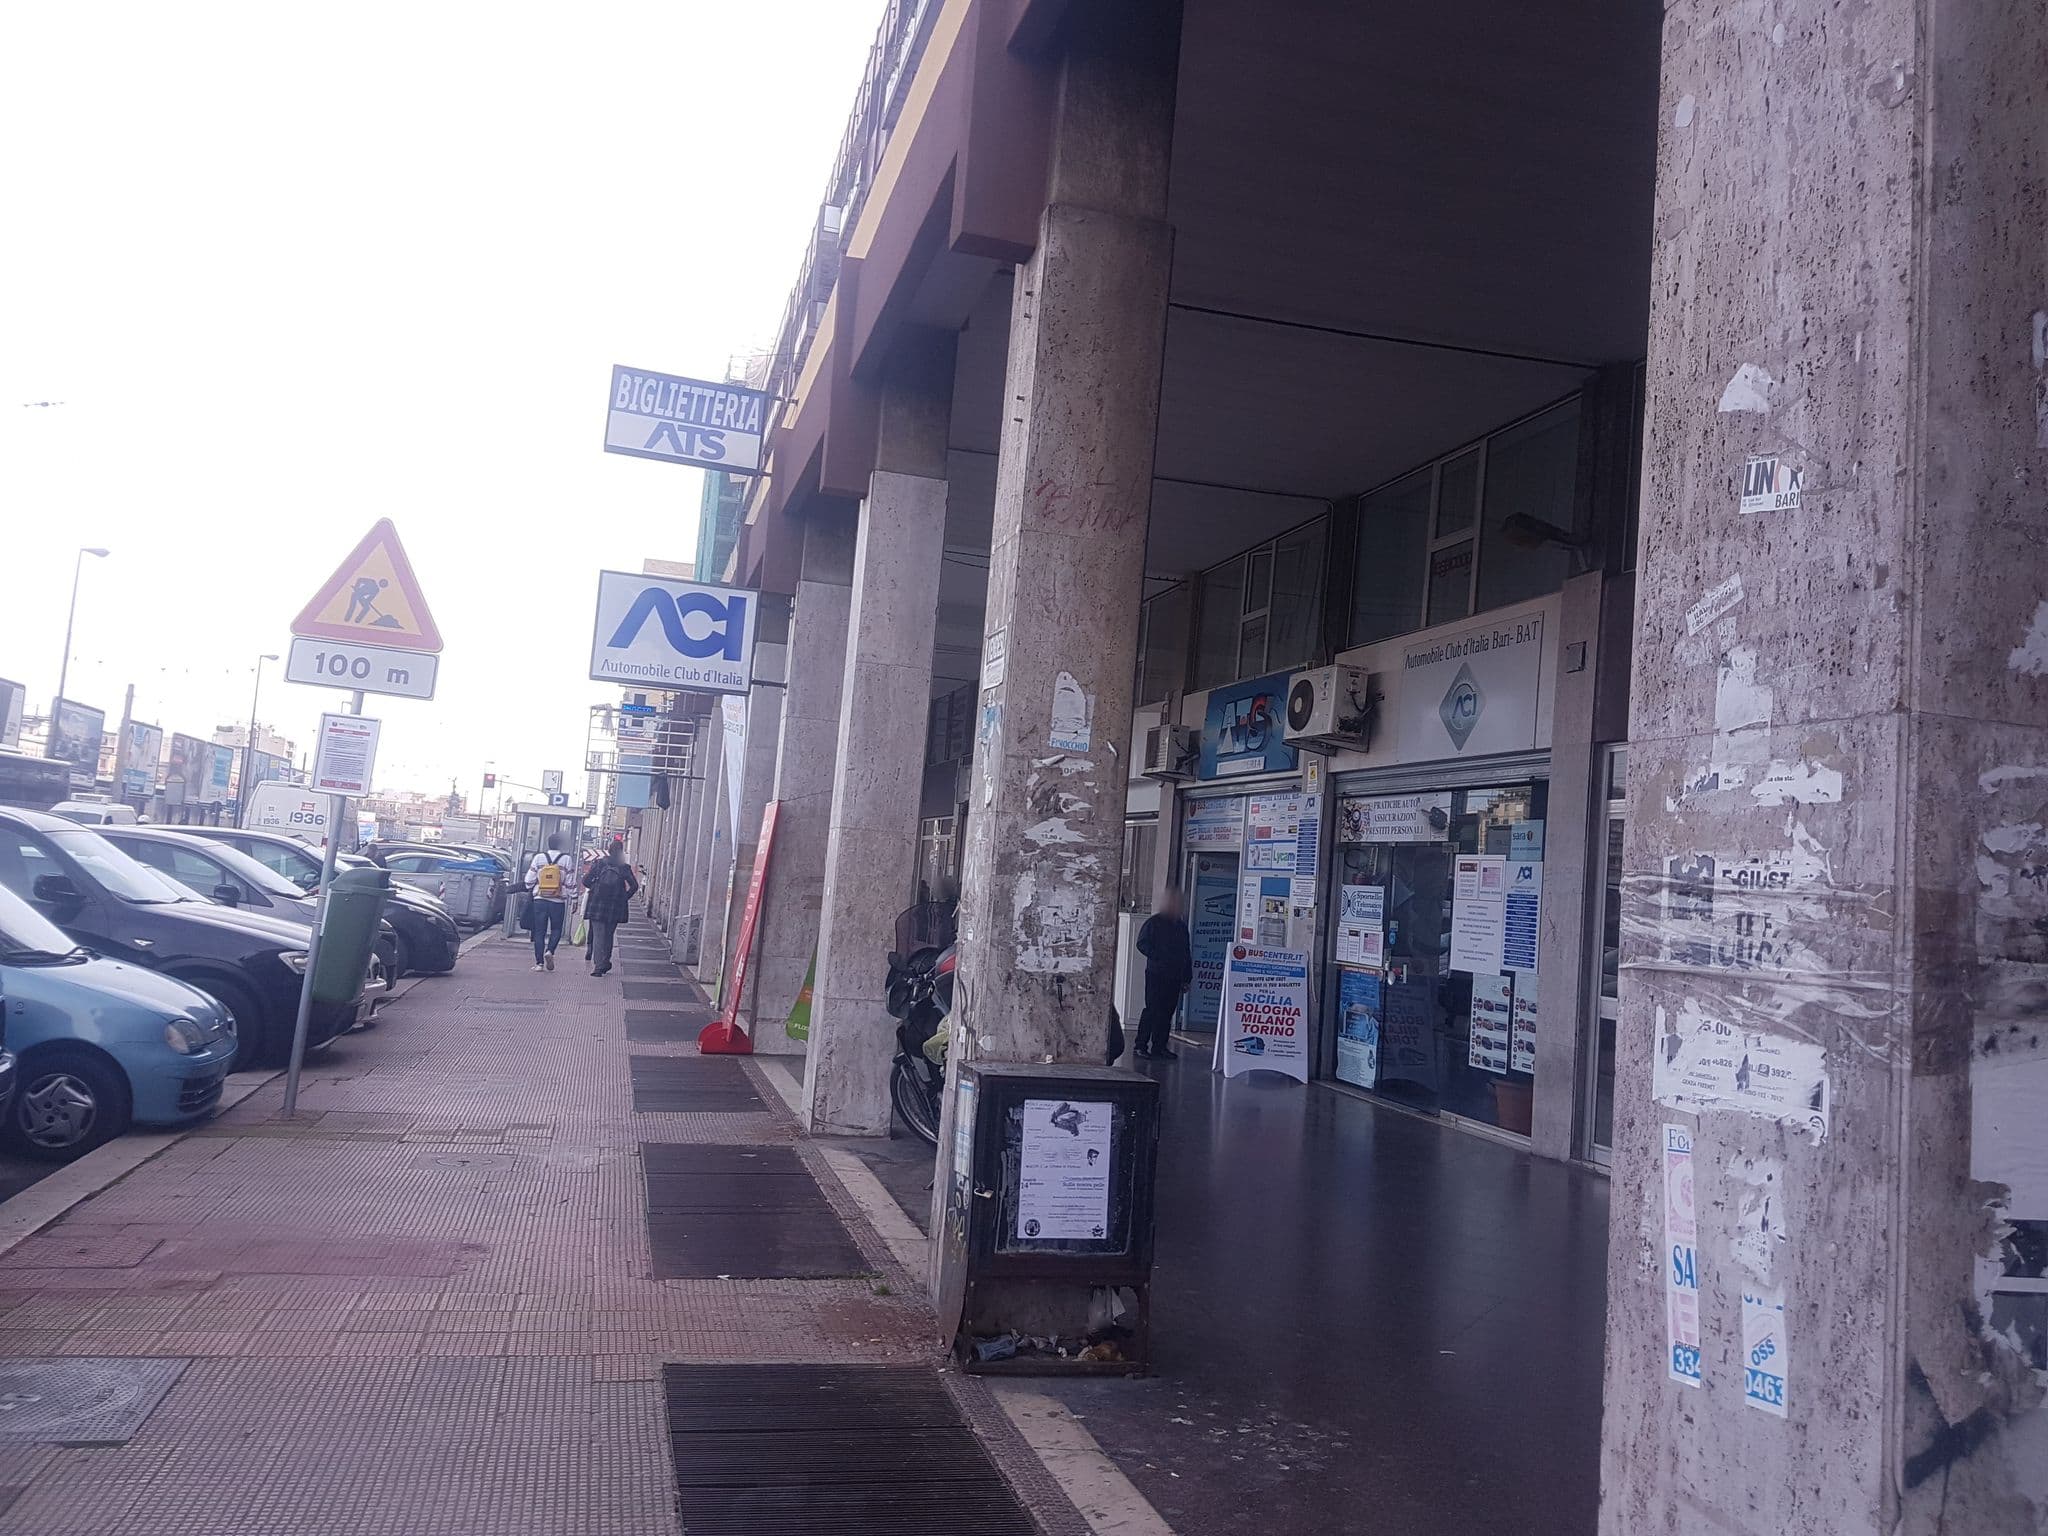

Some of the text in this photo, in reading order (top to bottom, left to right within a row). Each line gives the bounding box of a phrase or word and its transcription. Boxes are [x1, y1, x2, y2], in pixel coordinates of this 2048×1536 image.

[615, 374, 760, 432] BIGLIETTERIA
[643, 421, 727, 461] ATS
[1775, 493, 1800, 508] BARI
[607, 587, 747, 661] ACI
[1404, 645, 1444, 670] Automobile
[1445, 639, 1462, 661] Club
[1463, 634, 1490, 656] d'Italia
[1516, 620, 1540, 645] BAT
[316, 652, 410, 685] 100 m
[601, 659, 744, 687] Automobile Club d'Italia
[1452, 692, 1478, 720] ACI
[1217, 693, 1272, 755] ATS
[553, 795, 565, 806] P
[1374, 800, 1402, 810] PRATICHE
[263, 817, 280, 825] 1936
[289, 811, 326, 826] 1936
[1374, 812, 1417, 823] ASSICURAZIONI
[1391, 826, 1424, 836] PERSONALI
[1517, 866, 1533, 882] ACI
[1248, 949, 1303, 961] BUSCENTER.IT
[1243, 993, 1293, 1006] SICILIA
[1235, 1002, 1301, 1017] BOLOGNA
[1240, 1012, 1295, 1026] MILANO
[1242, 1023, 1295, 1037] TORINO
[1673, 1244, 1698, 1289] SA
